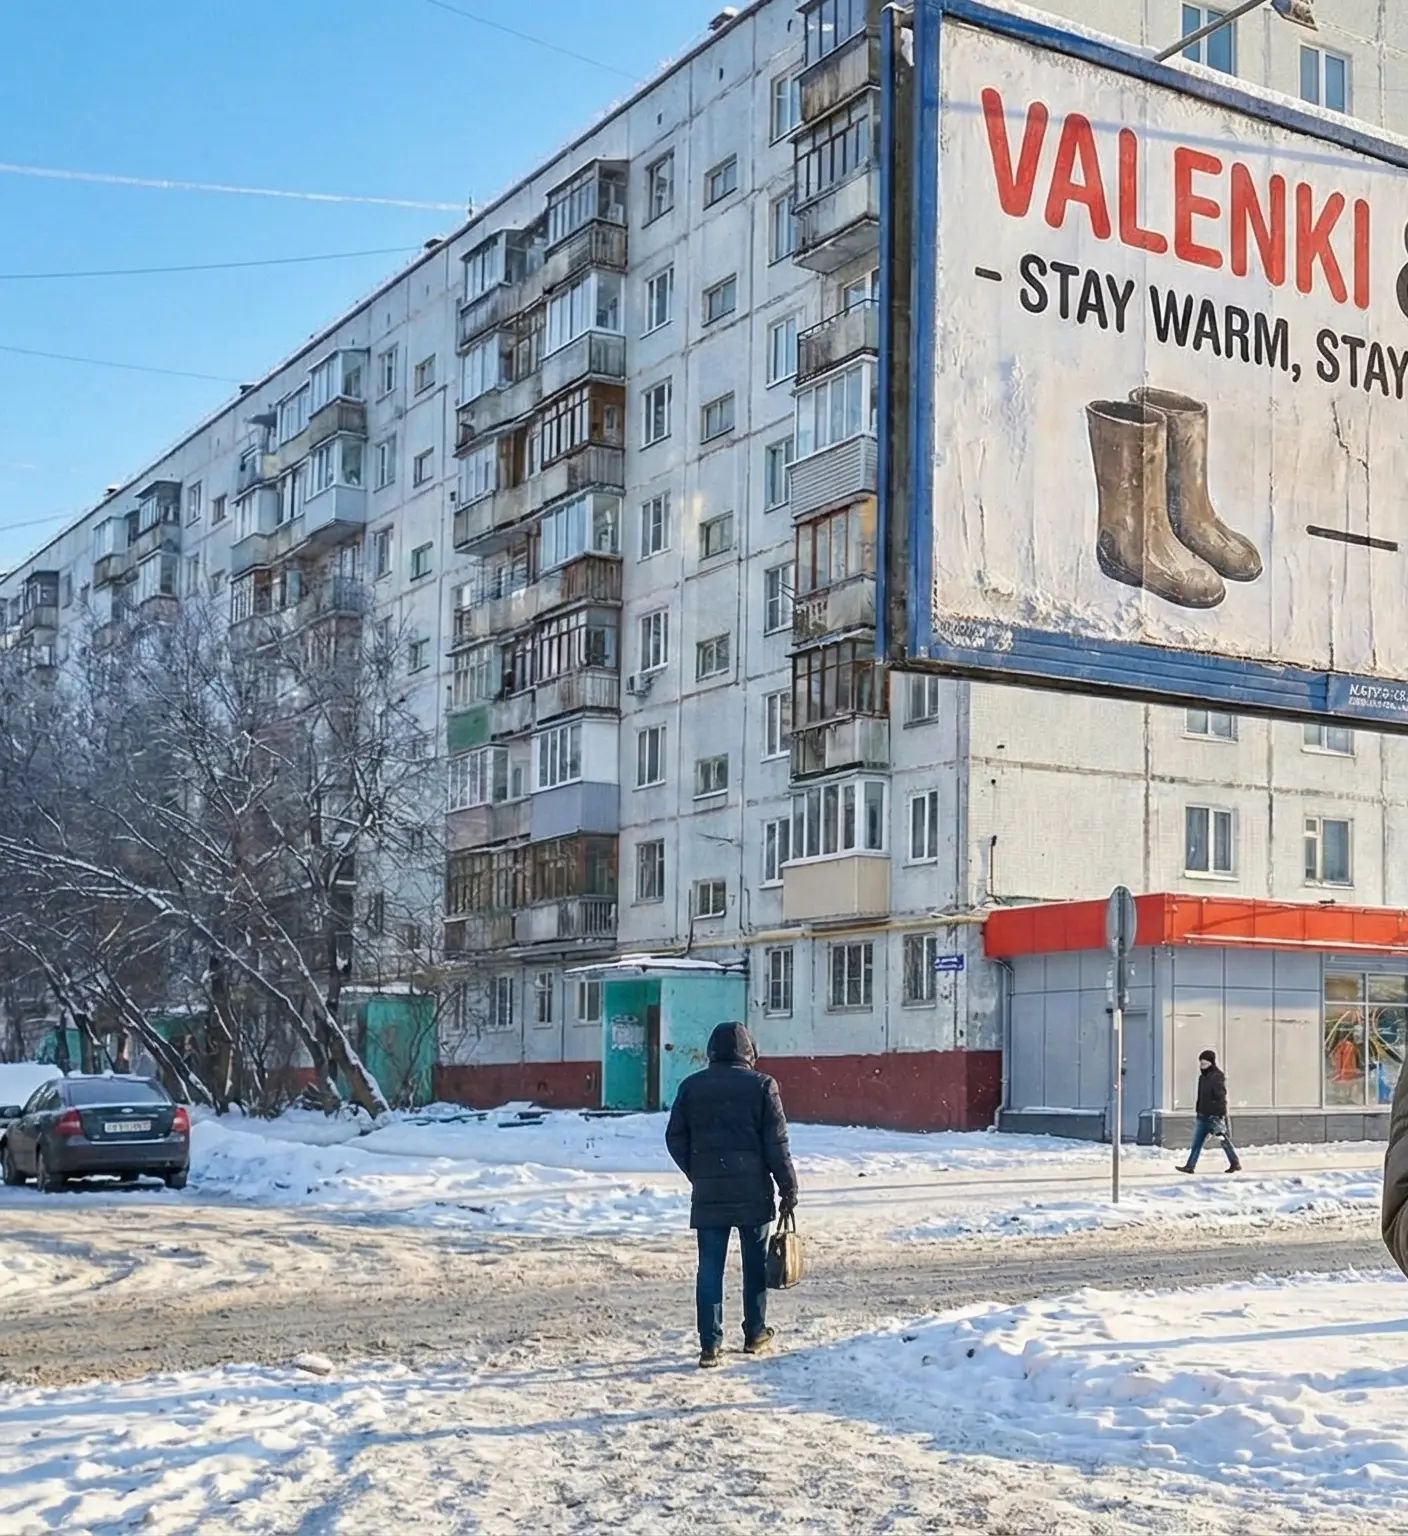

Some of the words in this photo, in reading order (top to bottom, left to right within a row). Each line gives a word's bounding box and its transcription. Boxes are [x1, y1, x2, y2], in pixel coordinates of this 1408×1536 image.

[980, 87, 1371, 310] VALENKI
[1019, 253, 1136, 335] STAY
[1149, 284, 1302, 384] WARM,
